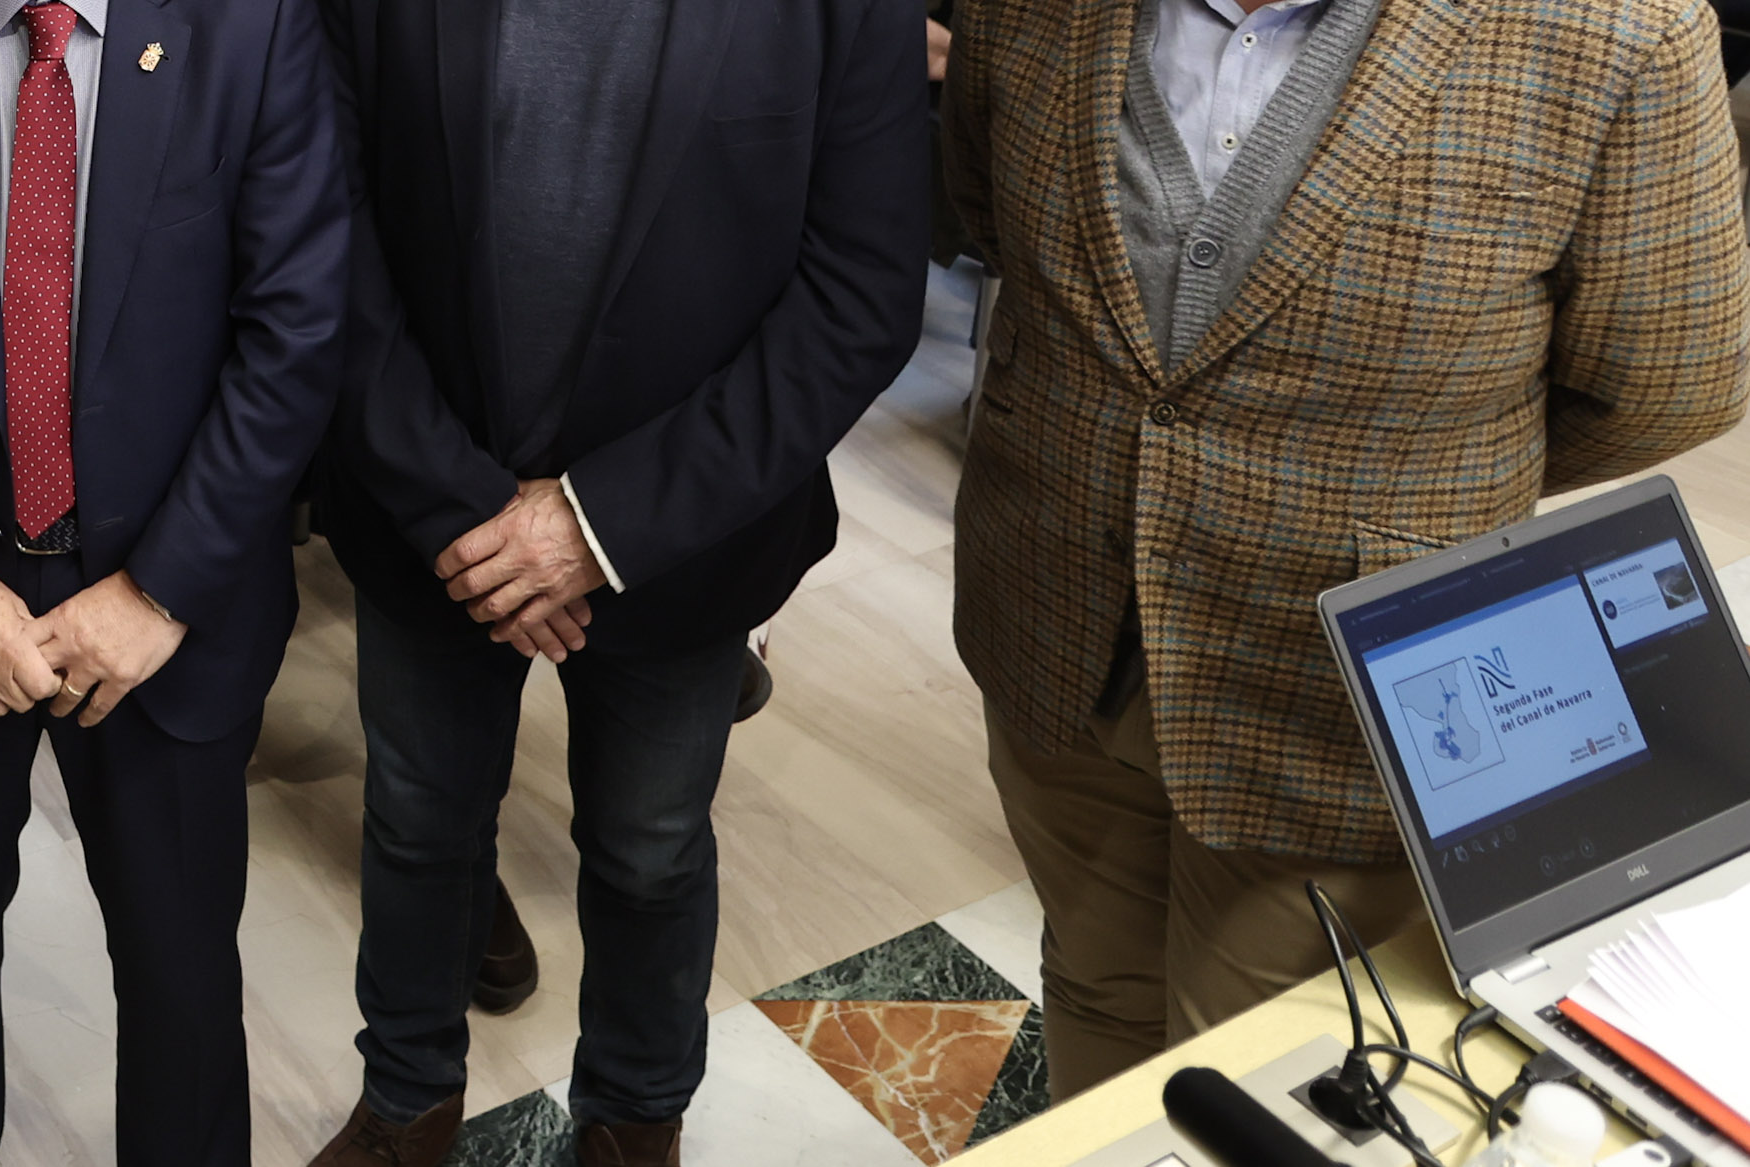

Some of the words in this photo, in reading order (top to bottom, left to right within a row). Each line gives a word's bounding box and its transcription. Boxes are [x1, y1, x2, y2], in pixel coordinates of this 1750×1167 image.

[1493, 692, 1533, 717] Segunda
[1532, 685, 1554, 700] Fase
[1500, 718, 1516, 734] del
[1516, 706, 1543, 727] Canal
[1543, 701, 1556, 716] de
[1556, 688, 1593, 711] Navarra
[1626, 863, 1650, 882] DELL
